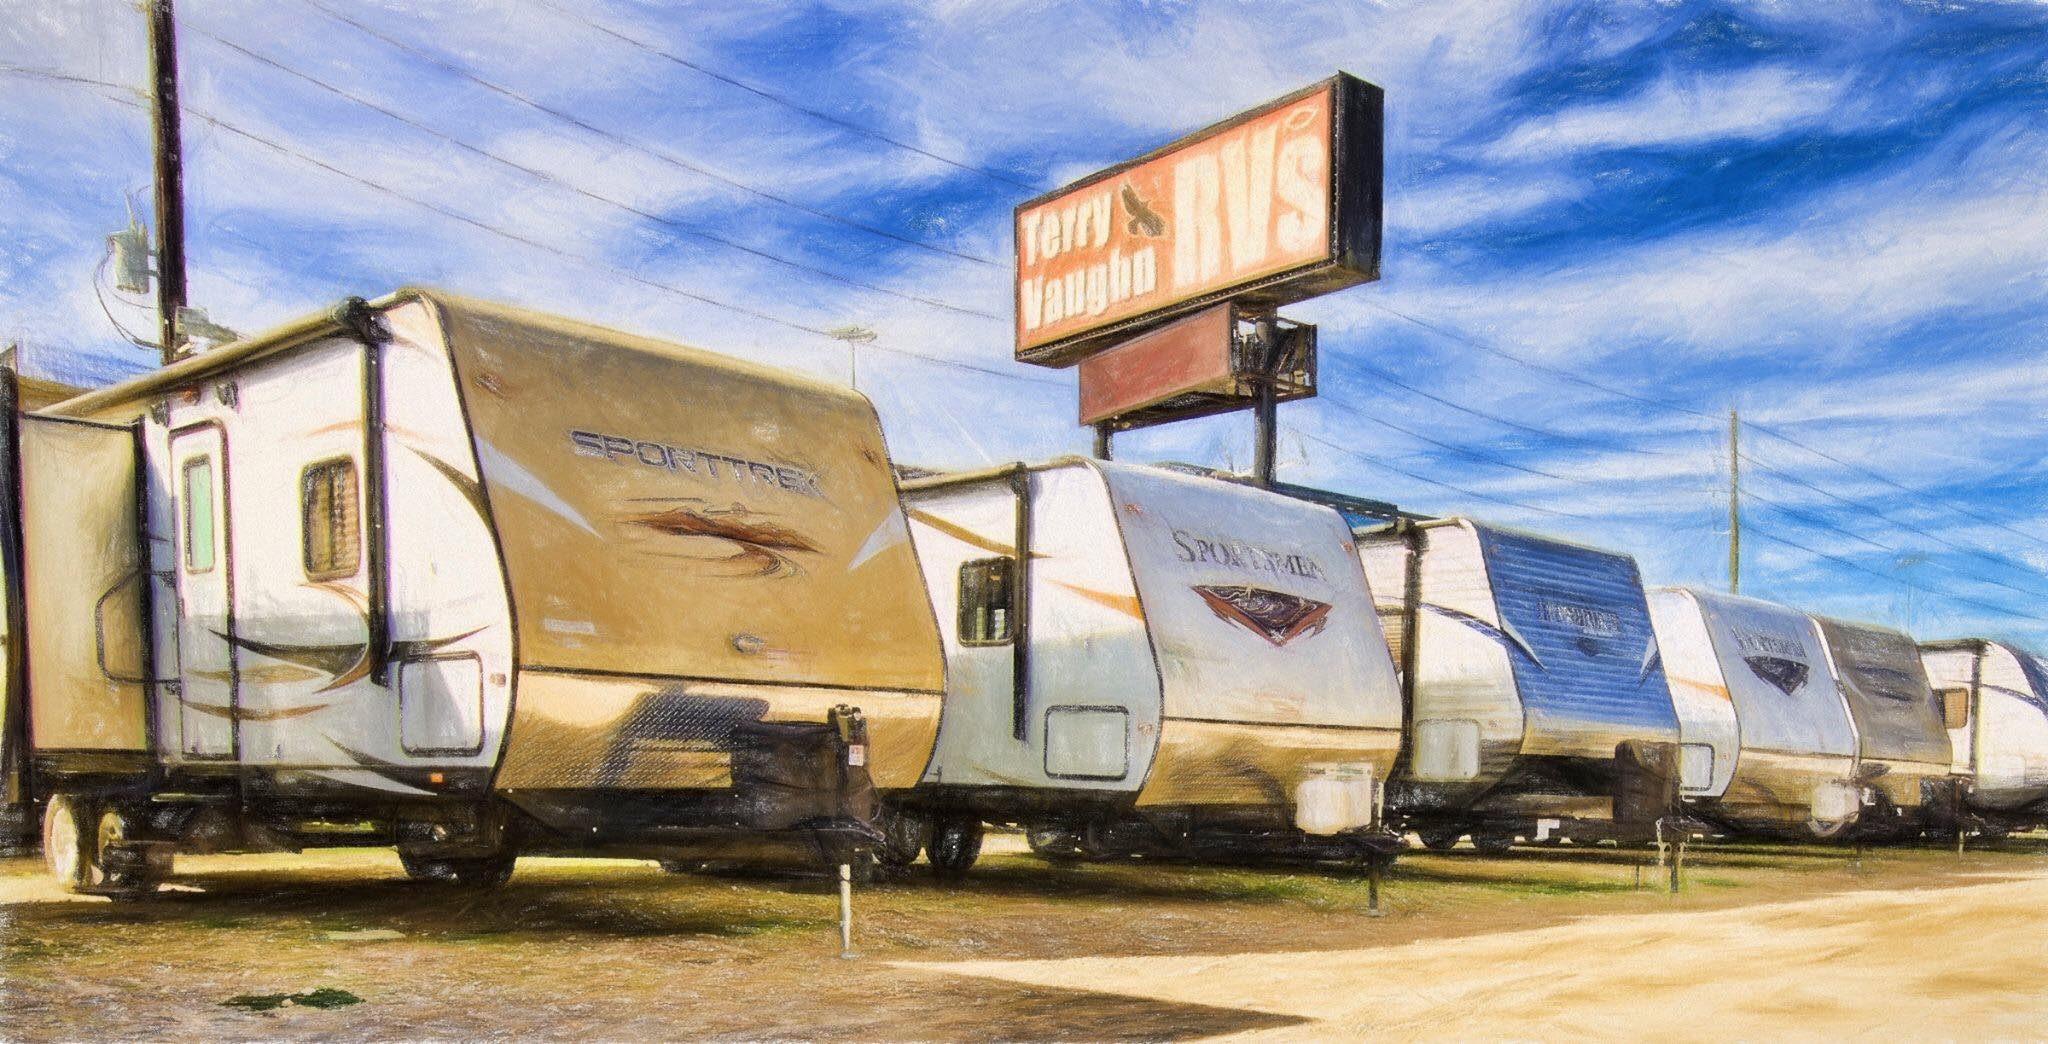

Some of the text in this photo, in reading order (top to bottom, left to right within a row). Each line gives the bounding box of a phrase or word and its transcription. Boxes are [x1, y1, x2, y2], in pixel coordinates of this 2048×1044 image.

[1022, 191, 1112, 267] Terry
[1022, 245, 1157, 332] Vaughn
[570, 429, 824, 497] SPORTTREK
